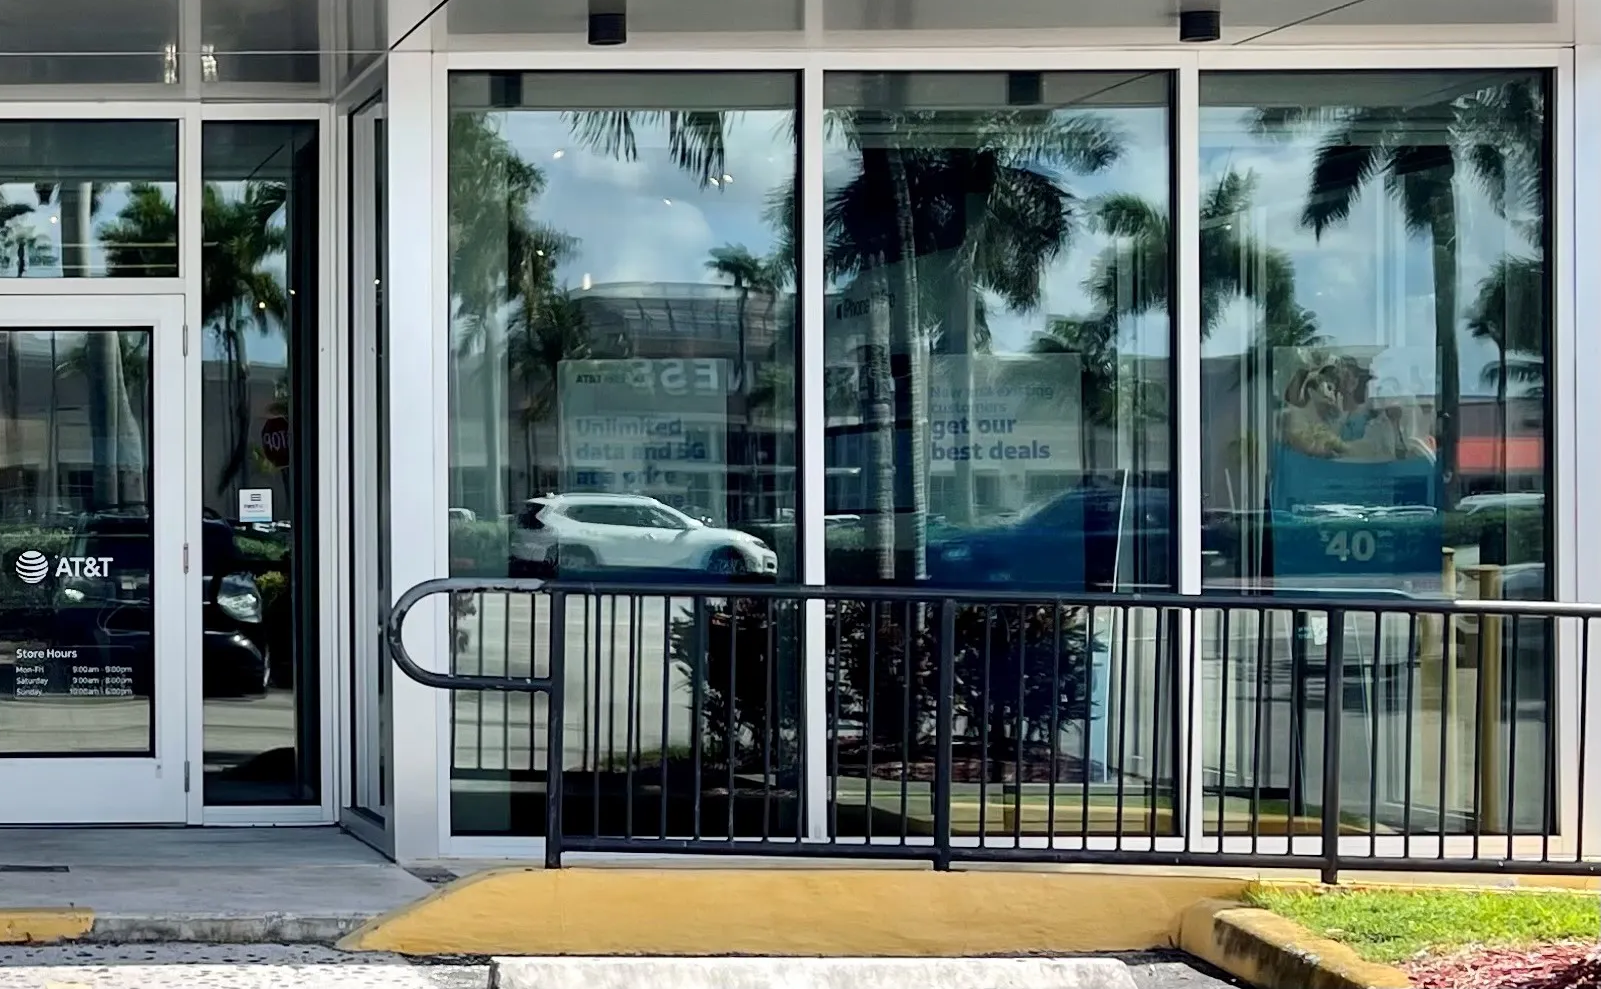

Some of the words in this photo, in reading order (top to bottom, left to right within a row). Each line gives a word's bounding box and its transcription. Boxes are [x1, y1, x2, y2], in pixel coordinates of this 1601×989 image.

[575, 417, 683, 438] Unlimited
[932, 417, 970, 440] get
[977, 419, 1017, 435] our
[575, 442, 625, 460] data
[631, 442, 671, 460] and
[677, 442, 706, 460] 5G
[932, 441, 983, 460] best
[989, 440, 1052, 460] deals
[55, 556, 114, 578] AT&T
[16, 648, 45, 659] Store
[46, 648, 78, 659] Hours
[15, 665, 45, 674] Mon-Fri
[16, 676, 49, 686] Saturday
[16, 688, 43, 697] Sunday
